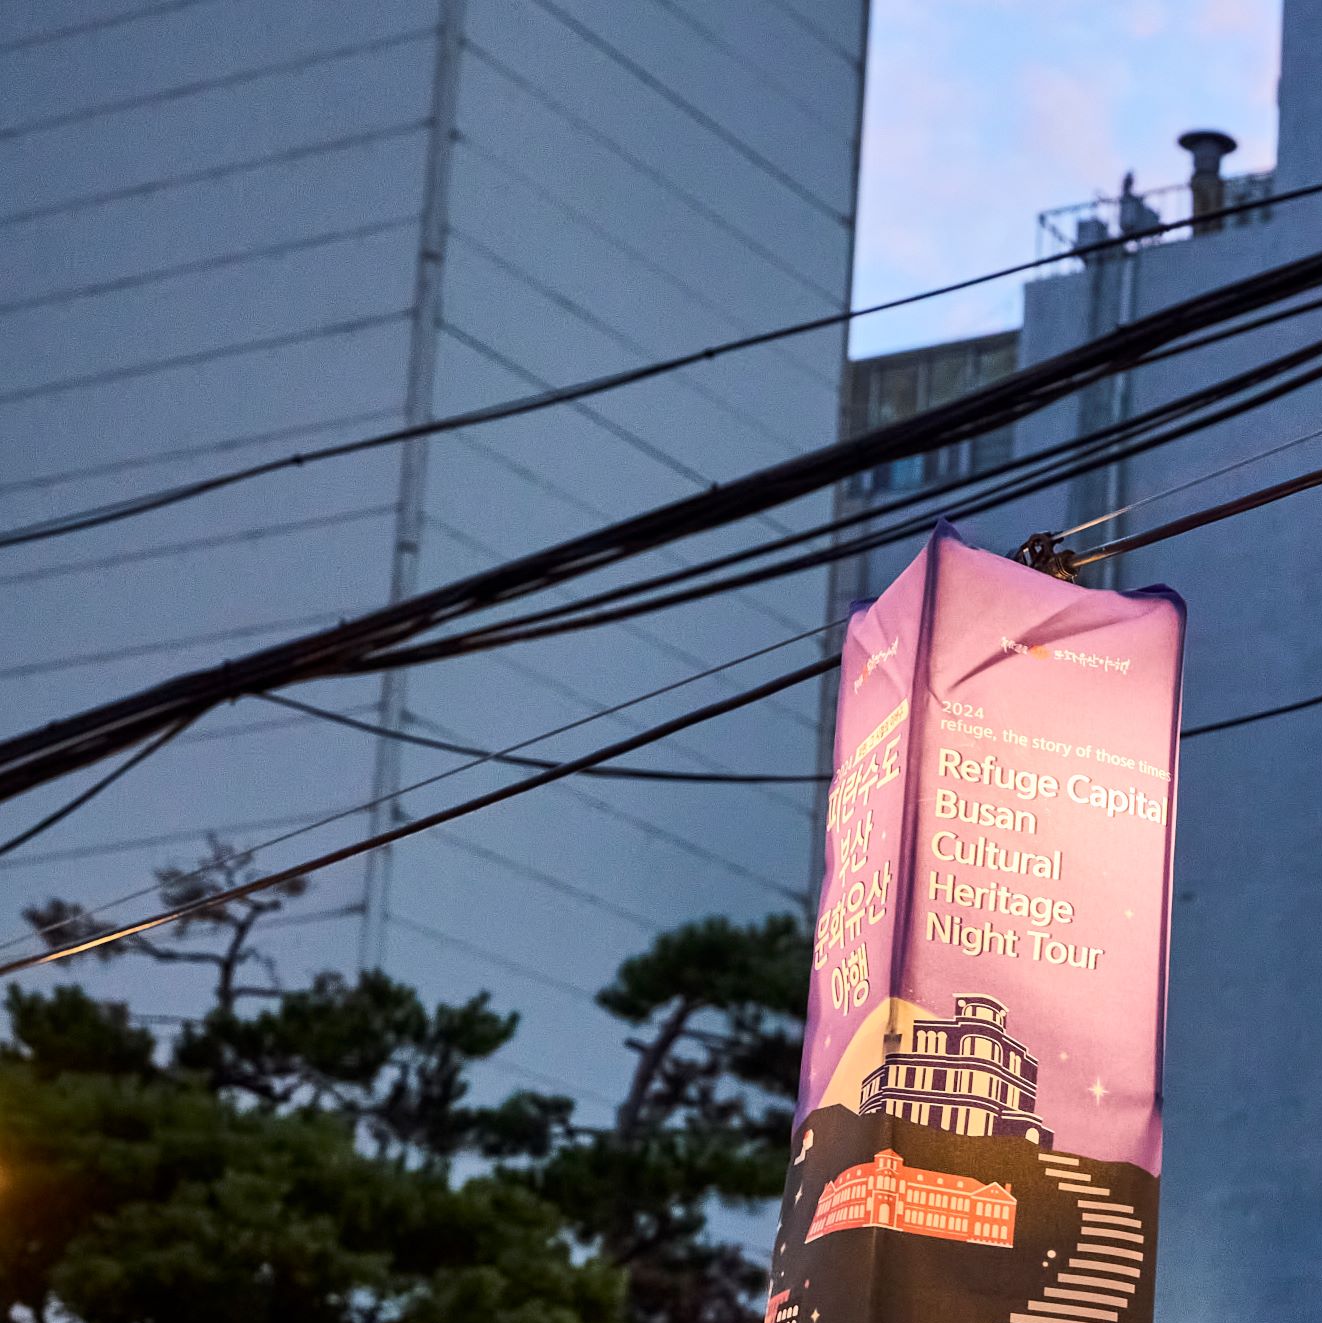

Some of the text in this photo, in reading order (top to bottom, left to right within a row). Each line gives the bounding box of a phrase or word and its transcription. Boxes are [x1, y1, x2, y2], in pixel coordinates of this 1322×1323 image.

[942, 700, 985, 719] 2024
[940, 718, 1172, 782] refuge, the story of those times
[826, 734, 901, 832] 피란수도
[935, 788, 1037, 834] Busan
[938, 748, 1169, 826] Refuge Capital
[838, 809, 874, 888] 부산
[931, 831, 1063, 881] Cultural
[814, 860, 893, 972] 문화유산
[928, 871, 1075, 927] Heritage
[926, 911, 1105, 970] Night Tour
[831, 941, 869, 1017] 야행
